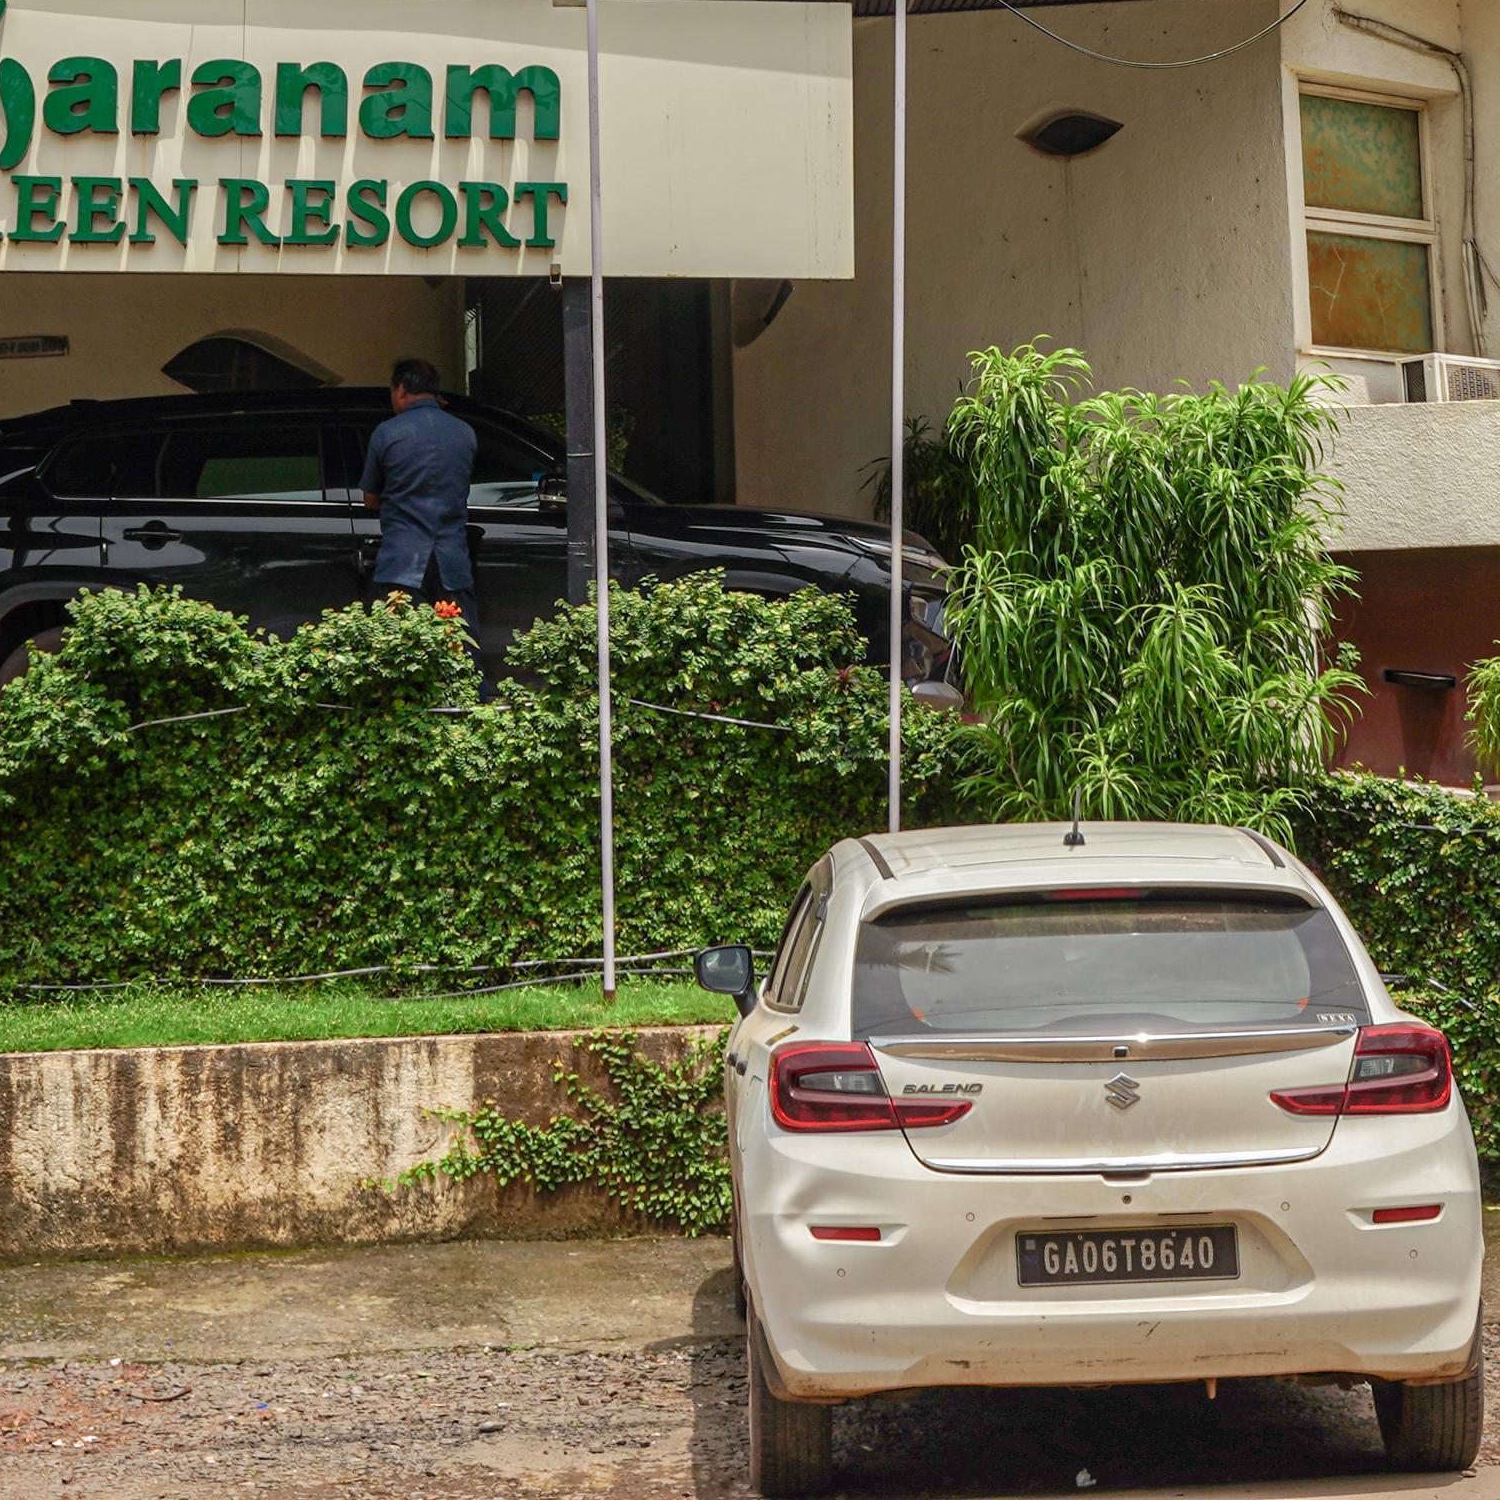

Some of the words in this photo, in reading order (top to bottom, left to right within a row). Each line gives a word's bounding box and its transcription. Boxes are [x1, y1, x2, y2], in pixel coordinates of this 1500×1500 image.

[216, 178, 568, 250] RESORT
[902, 1083, 983, 1095] BALENO
[1043, 1236, 1215, 1275] GA06T8640
